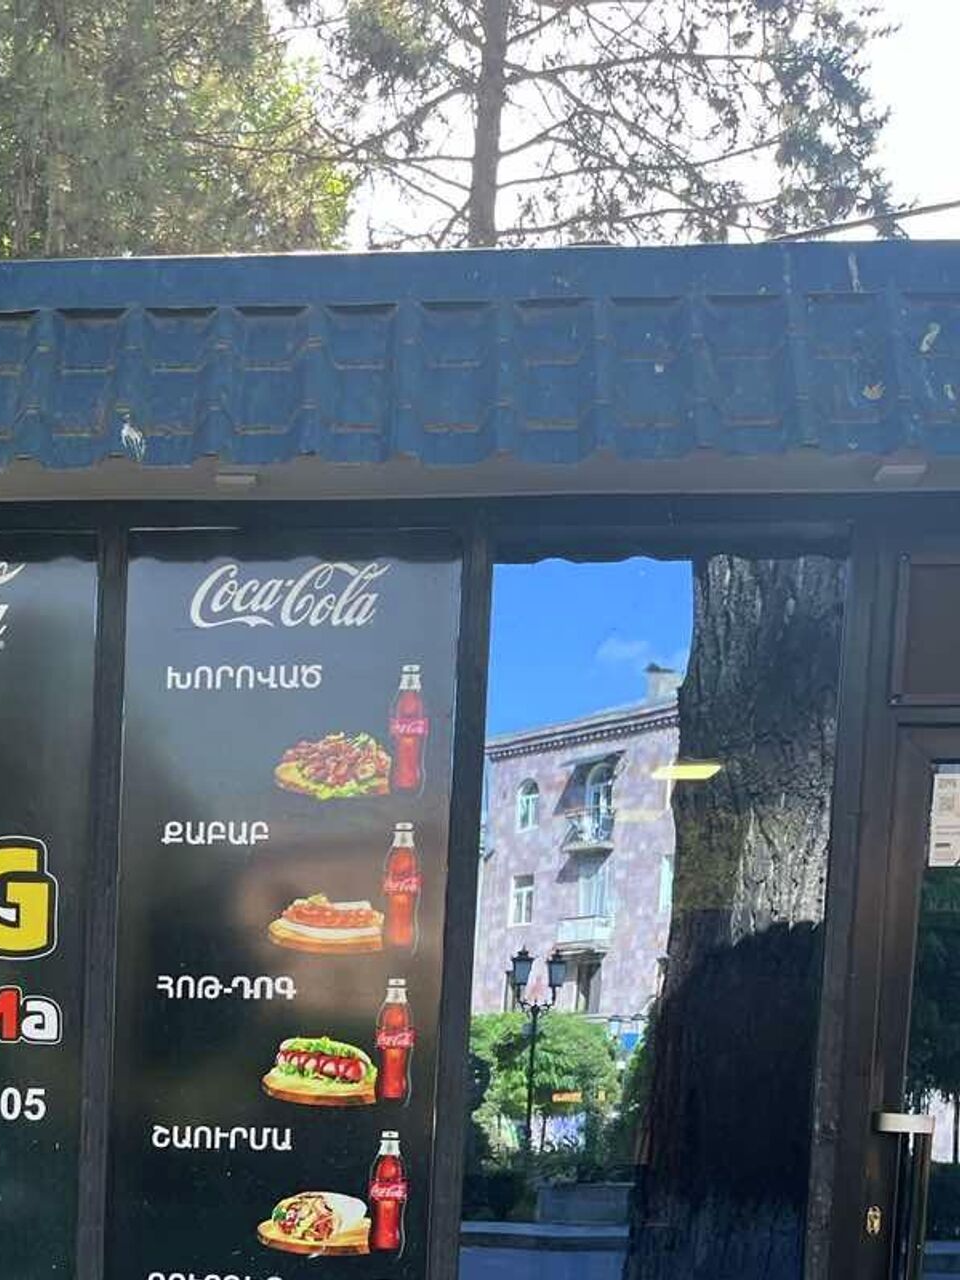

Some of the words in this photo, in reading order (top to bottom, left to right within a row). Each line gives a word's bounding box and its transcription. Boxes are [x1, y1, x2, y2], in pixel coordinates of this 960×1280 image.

[190, 562, 390, 628] Coca-Cola
[166, 664, 323, 690] ԽՈՐՈՎԱԾ
[161, 821, 270, 846] ՔԱԲԱԲ
[156, 974, 297, 1000] ՀՈԹ-ԴՈԳ
[0, 1087, 47, 1121] 05
[151, 1125, 293, 1151] ՇԱՈՒՐՄԱ
